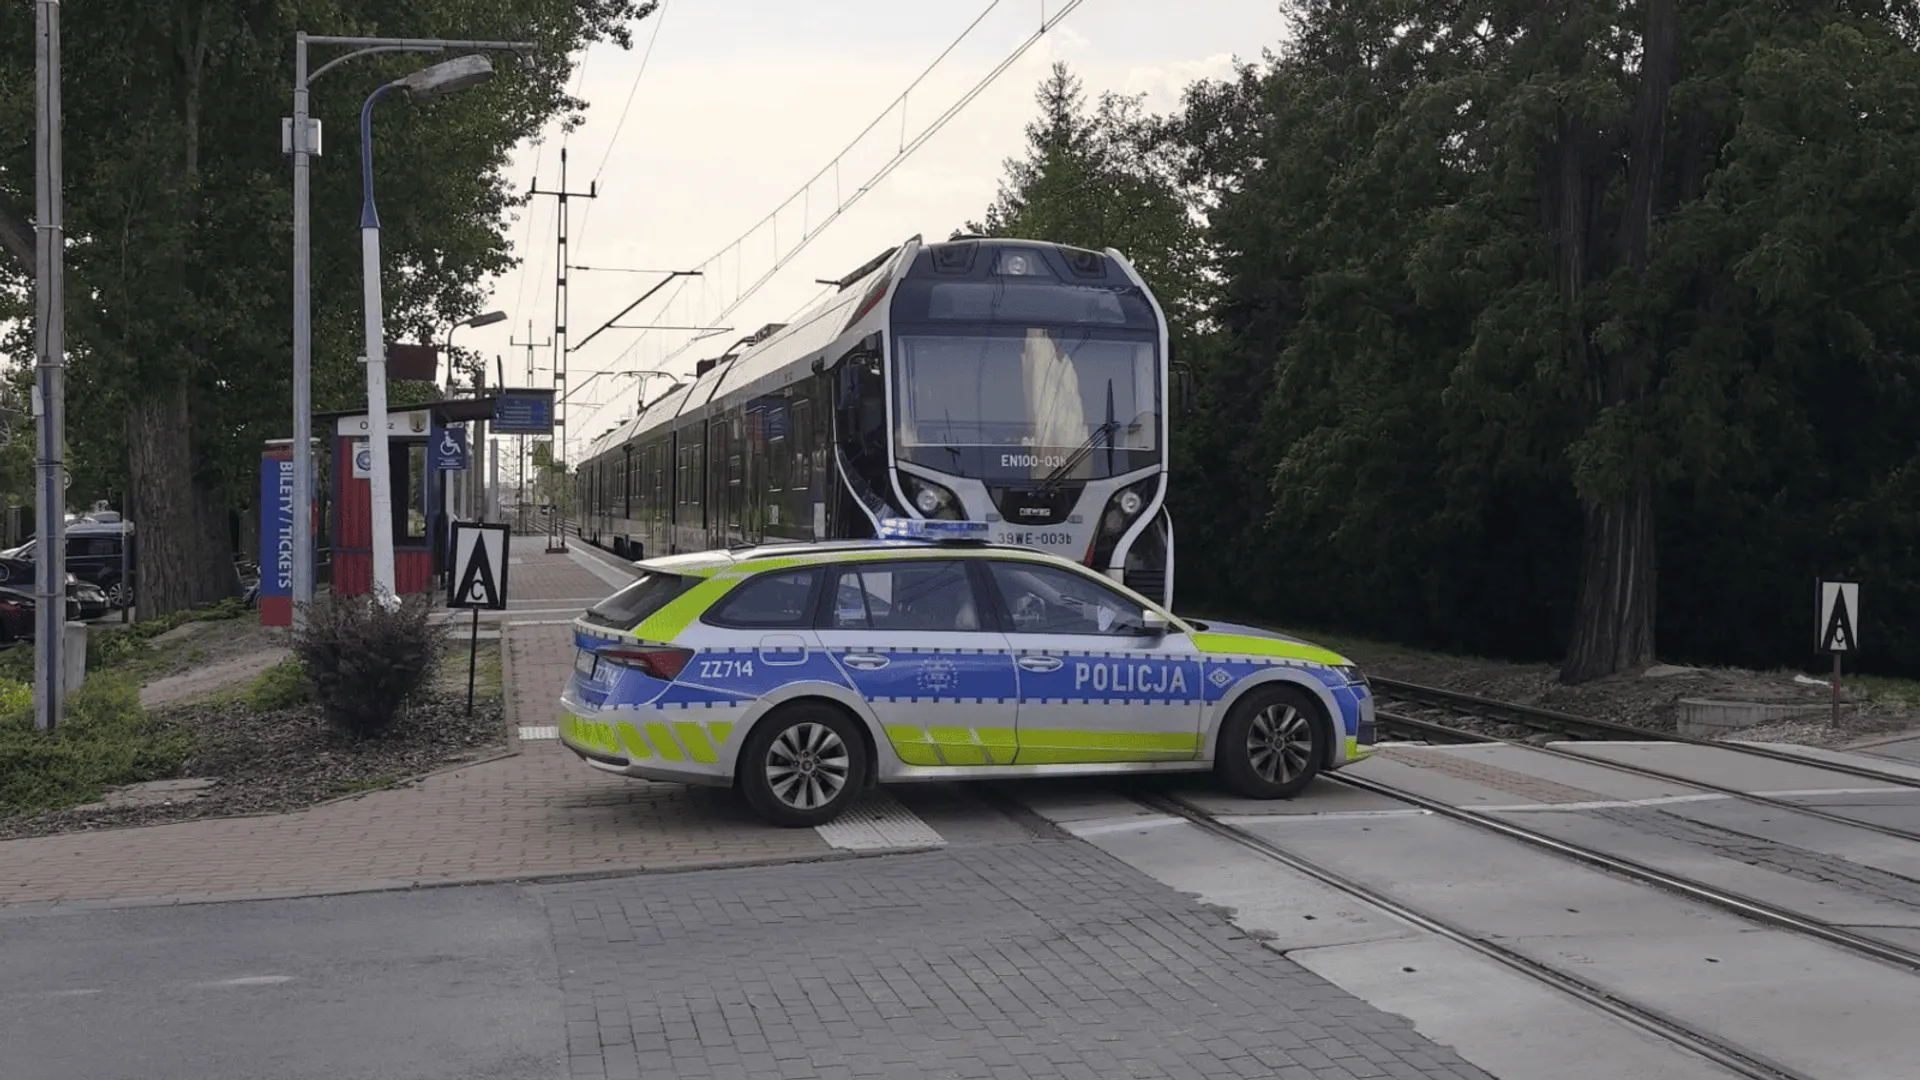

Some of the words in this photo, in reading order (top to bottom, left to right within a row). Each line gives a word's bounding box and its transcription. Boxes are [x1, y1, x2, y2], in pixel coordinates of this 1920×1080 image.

[279, 461, 293, 514] BILETY
[998, 532, 1072, 545] 39WE-003b
[278, 525, 293, 589] TICKETS
[700, 660, 754, 678] ZZ714
[1075, 662, 1187, 694] POLICJA
